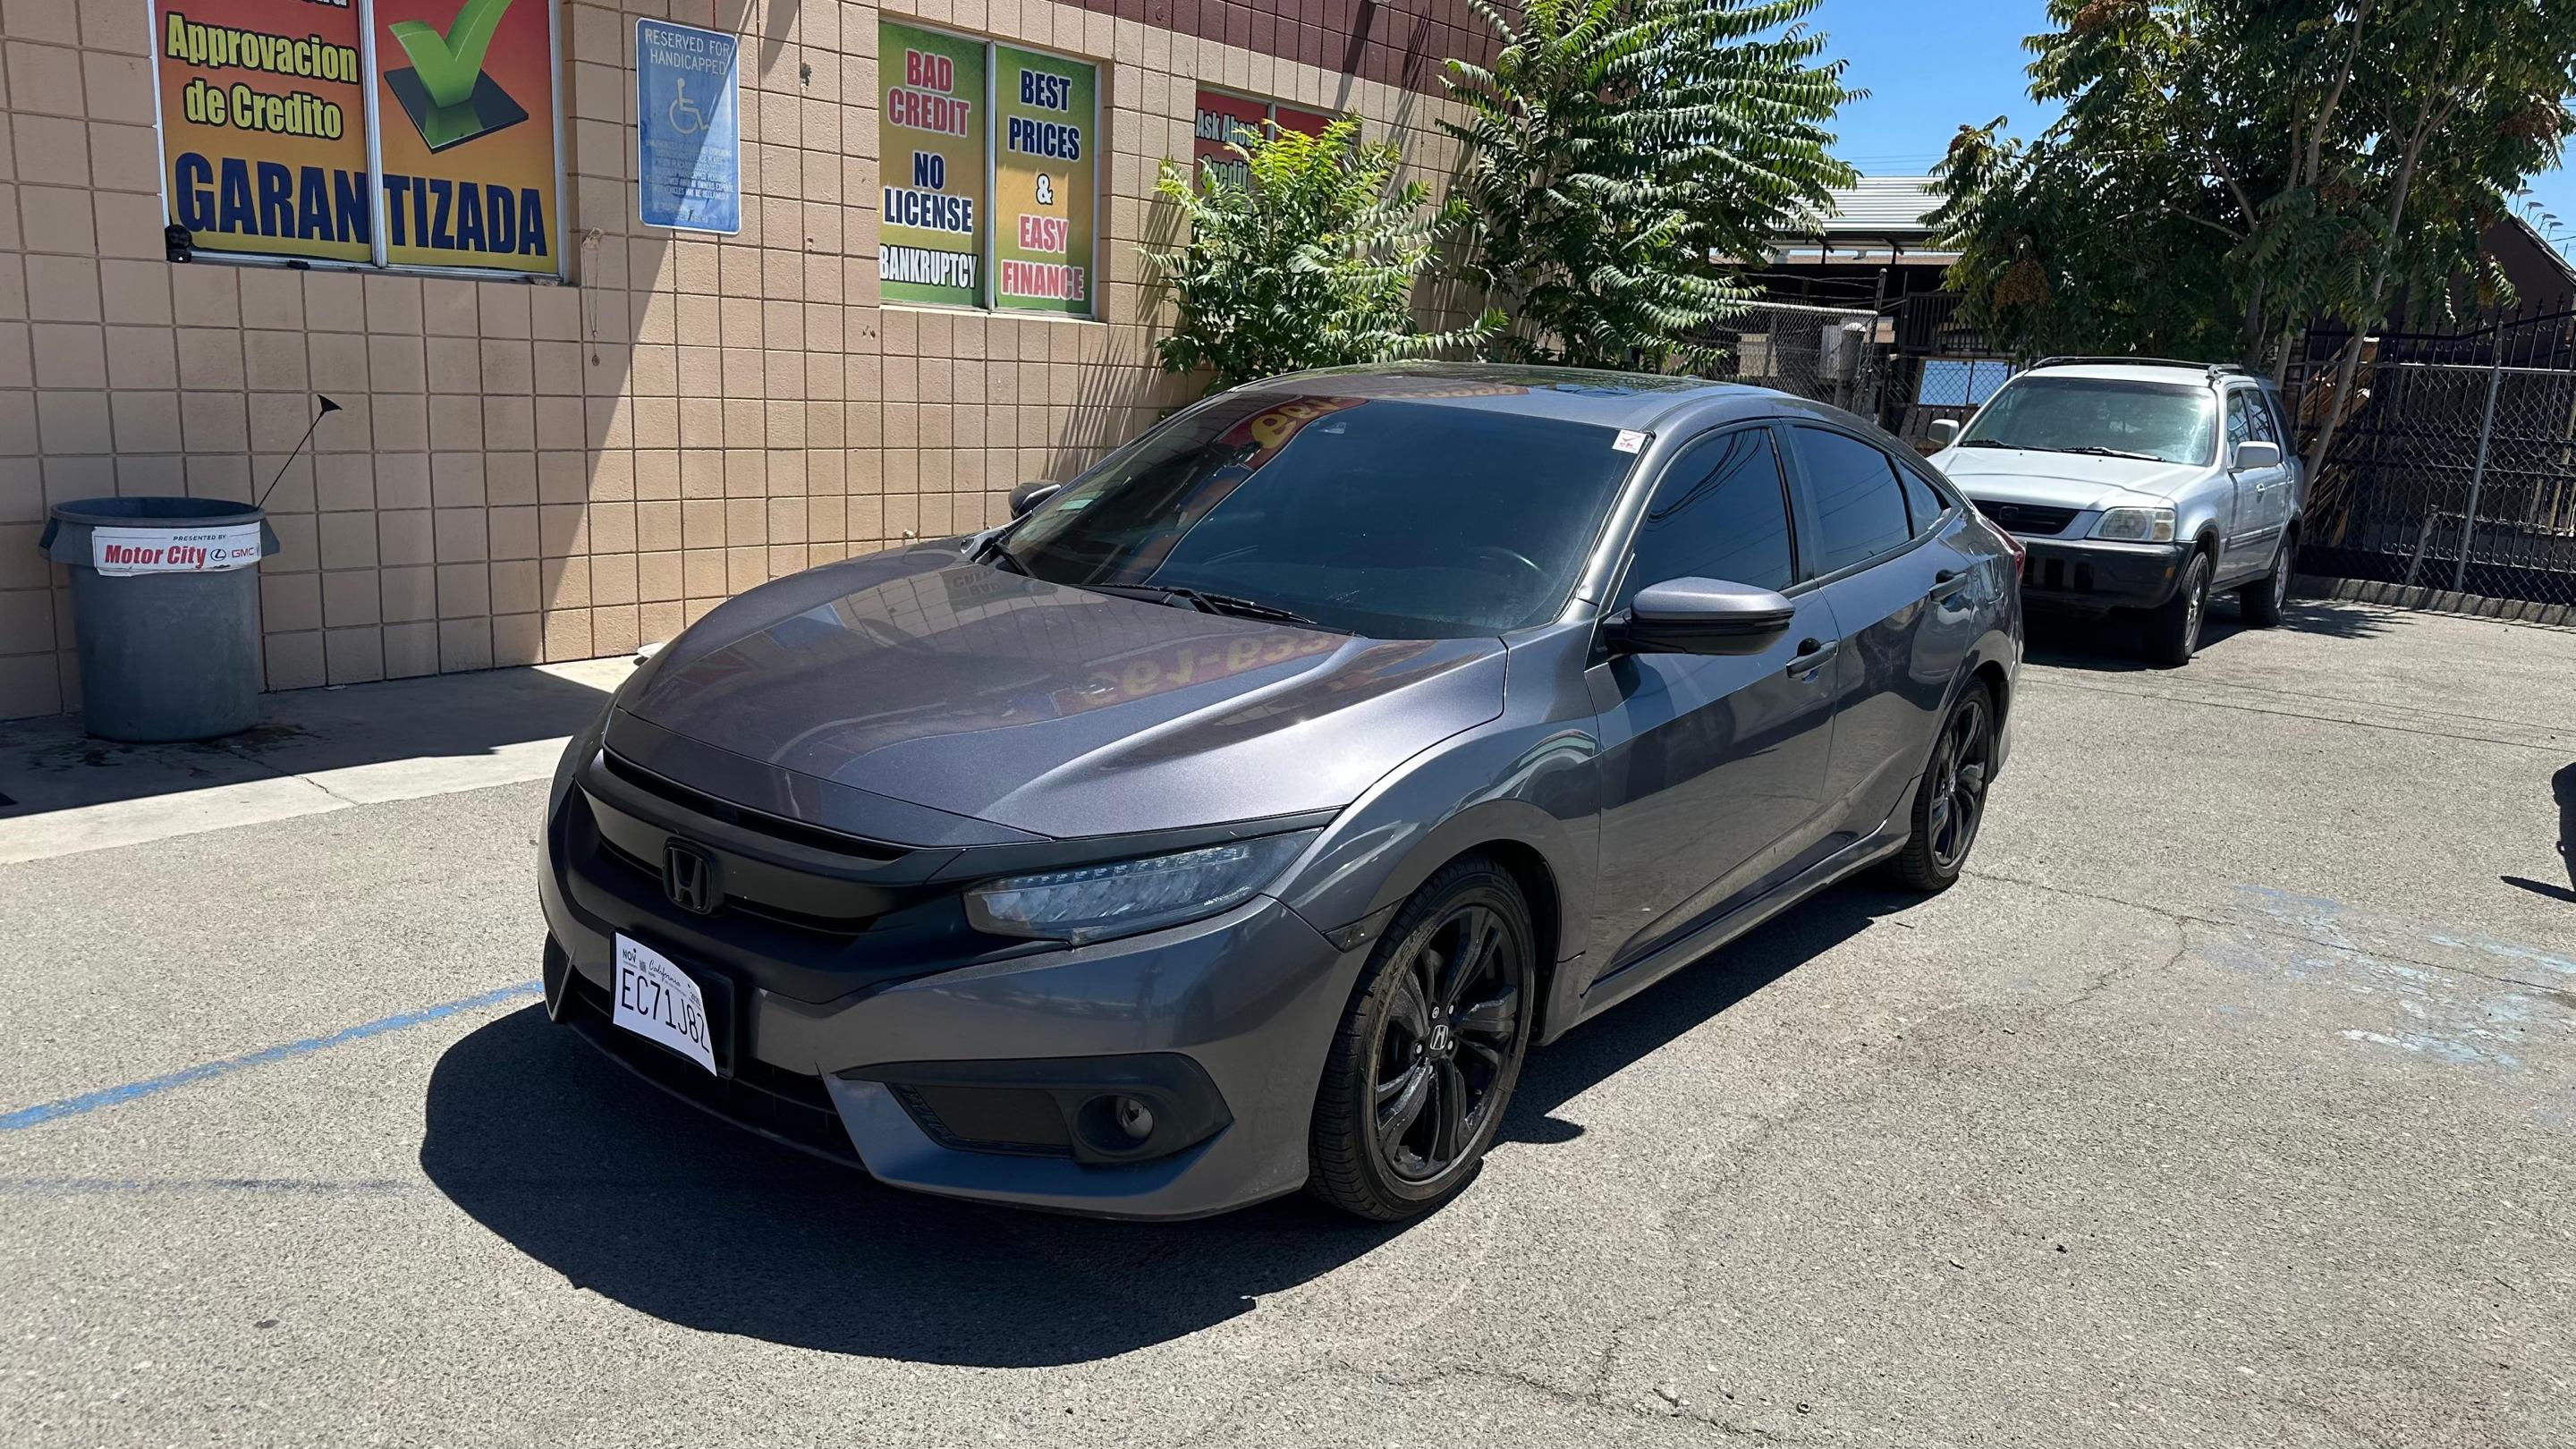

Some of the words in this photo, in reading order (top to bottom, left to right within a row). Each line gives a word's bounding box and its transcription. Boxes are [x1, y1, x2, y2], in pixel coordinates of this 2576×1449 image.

[166, 12, 358, 83] Approvacion
[645, 29, 704, 53] RESERVED
[709, 40, 731, 57] FOR
[650, 49, 726, 75] HANDICAPPED
[905, 49, 953, 92] BAD
[184, 79, 225, 125] de
[232, 83, 343, 139] Credito
[1021, 71, 1071, 111] BEST
[888, 88, 970, 136] CREDIT
[1195, 108, 1220, 140] Ask
[1009, 118, 1080, 161] PRICES
[913, 151, 945, 190] NO
[1036, 173, 1054, 206] &
[884, 189, 973, 233] LICENSE
[1020, 215, 1069, 254] EASY
[879, 244, 978, 288] BANKRUPTCY
[1001, 261, 1084, 301] FINANCE
[105, 545, 164, 564] Motor
[167, 546, 208, 570] City
[232, 547, 255, 558] GMC
[648, 960, 682, 987] California
[621, 967, 710, 1054] EC71J82
